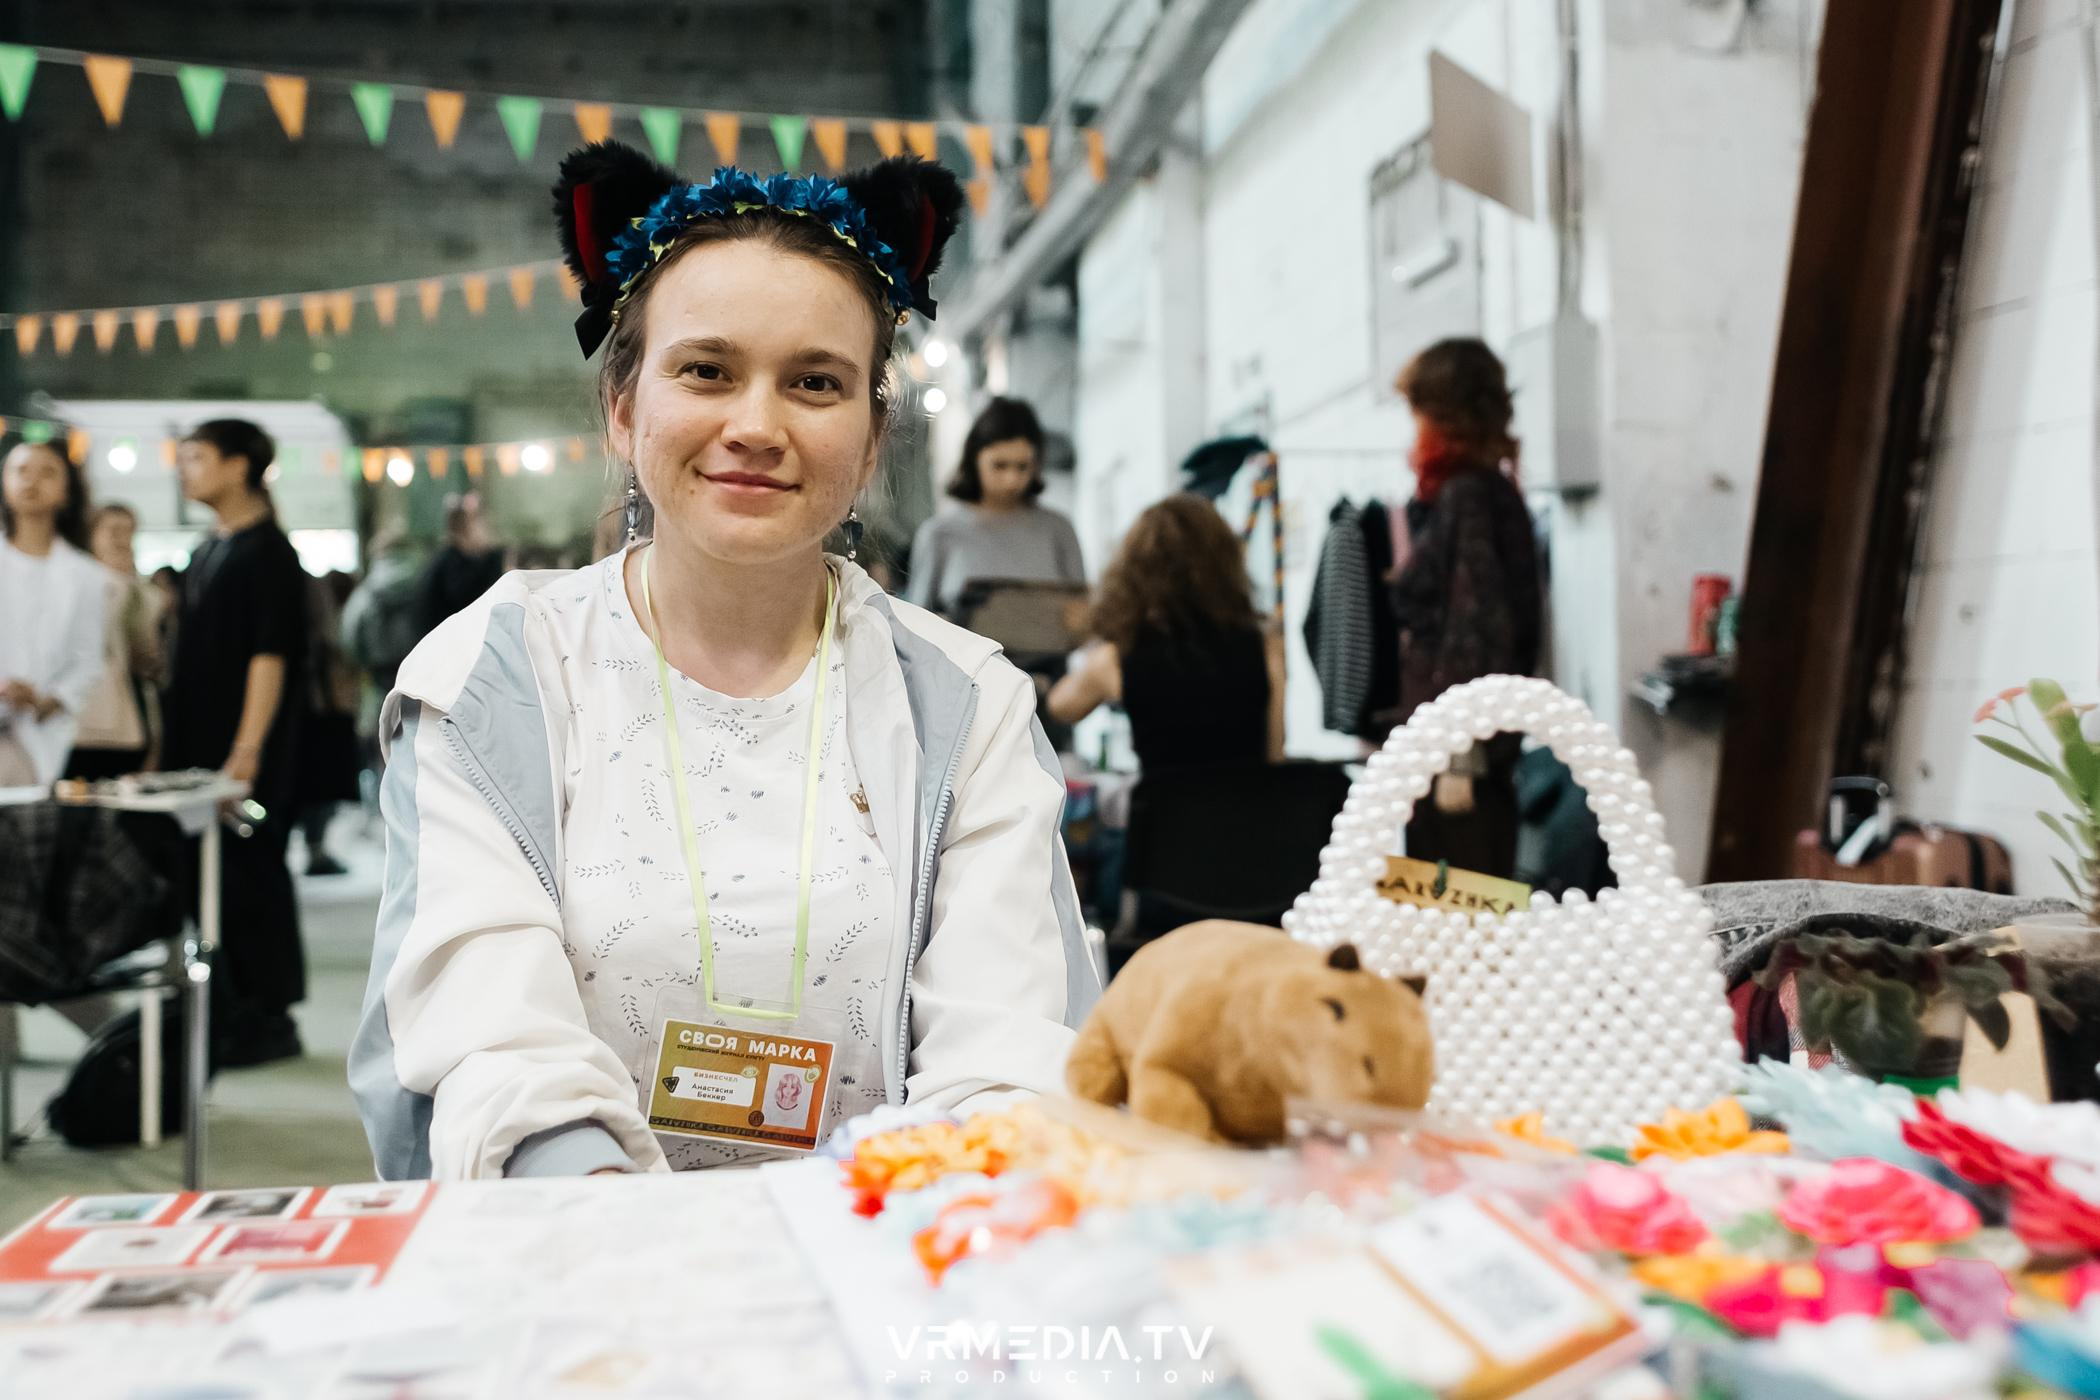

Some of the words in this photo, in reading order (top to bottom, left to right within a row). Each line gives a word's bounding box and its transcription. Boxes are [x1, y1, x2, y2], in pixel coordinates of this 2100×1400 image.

[679, 1029, 738, 1050] СВОЯ
[748, 1039, 816, 1062] МАРКА
[693, 1071, 738, 1083] БИЗНЕСЧЕЛ
[691, 1083, 734, 1094] Анастасия
[697, 1091, 726, 1101] Беккер
